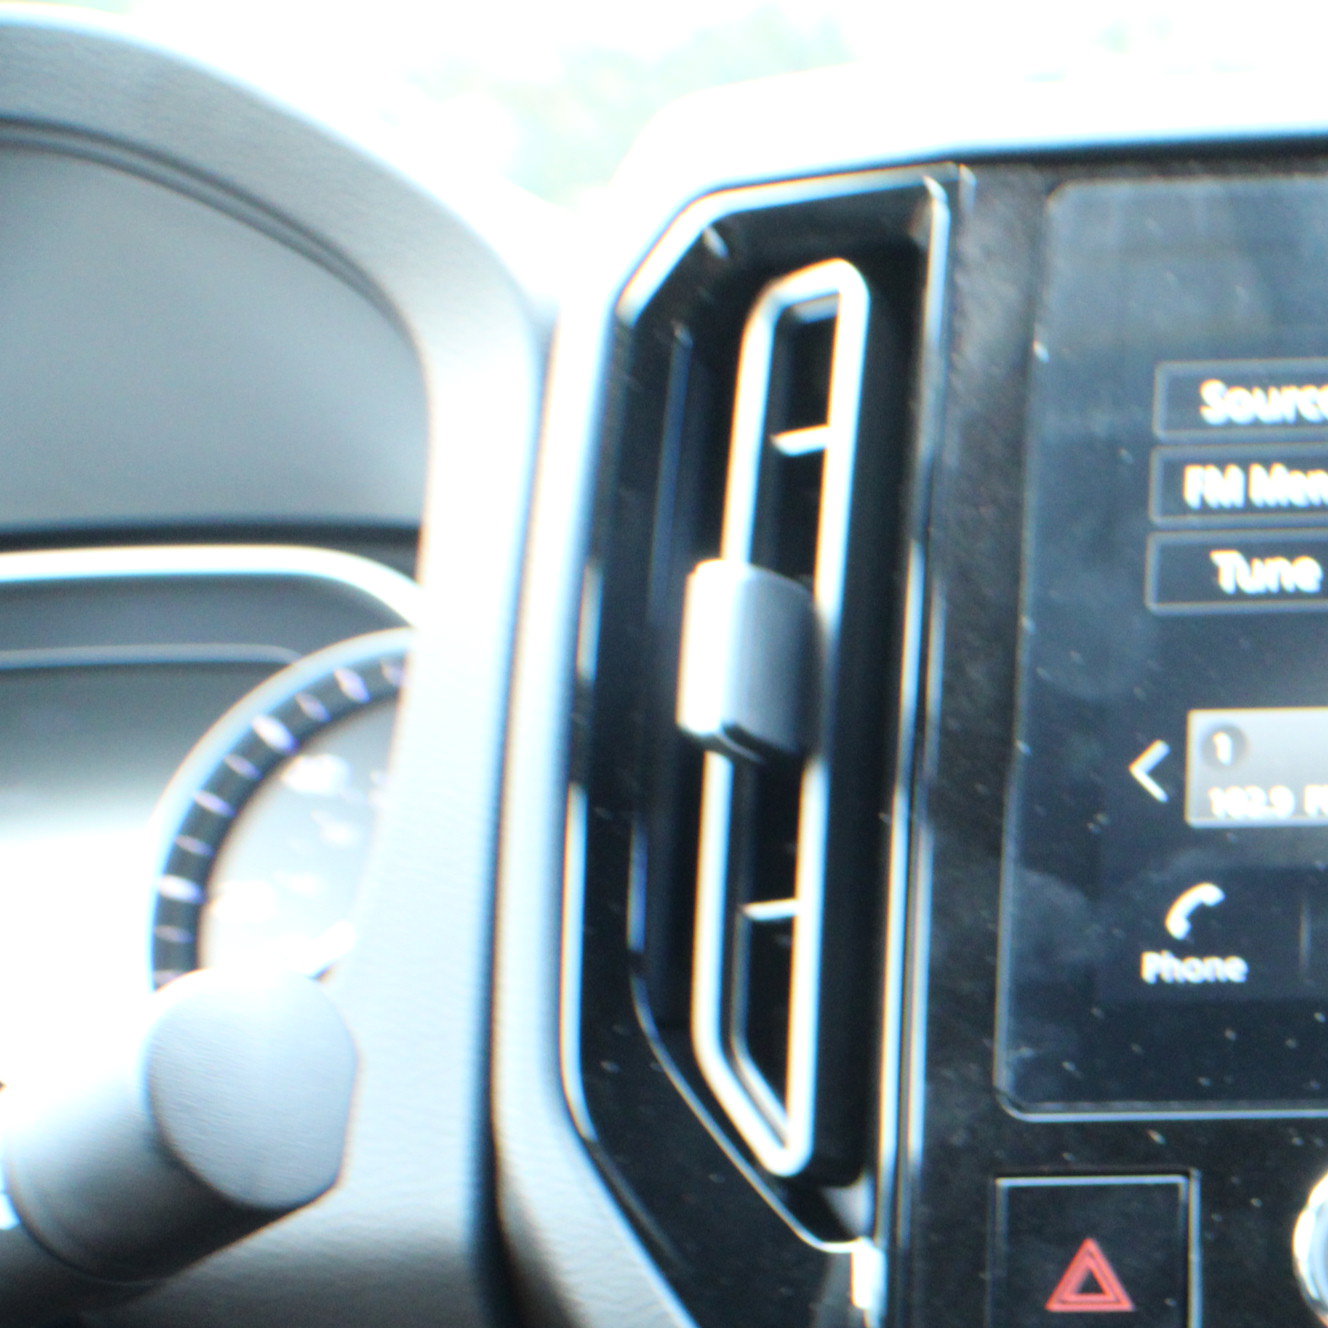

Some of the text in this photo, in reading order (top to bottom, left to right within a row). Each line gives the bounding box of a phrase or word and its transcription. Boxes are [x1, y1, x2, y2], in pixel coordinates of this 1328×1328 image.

[1184, 464, 1244, 509] FM
[1212, 550, 1323, 594] Tune
[1211, 729, 1233, 765] 1
[1141, 951, 1248, 985] Phone
